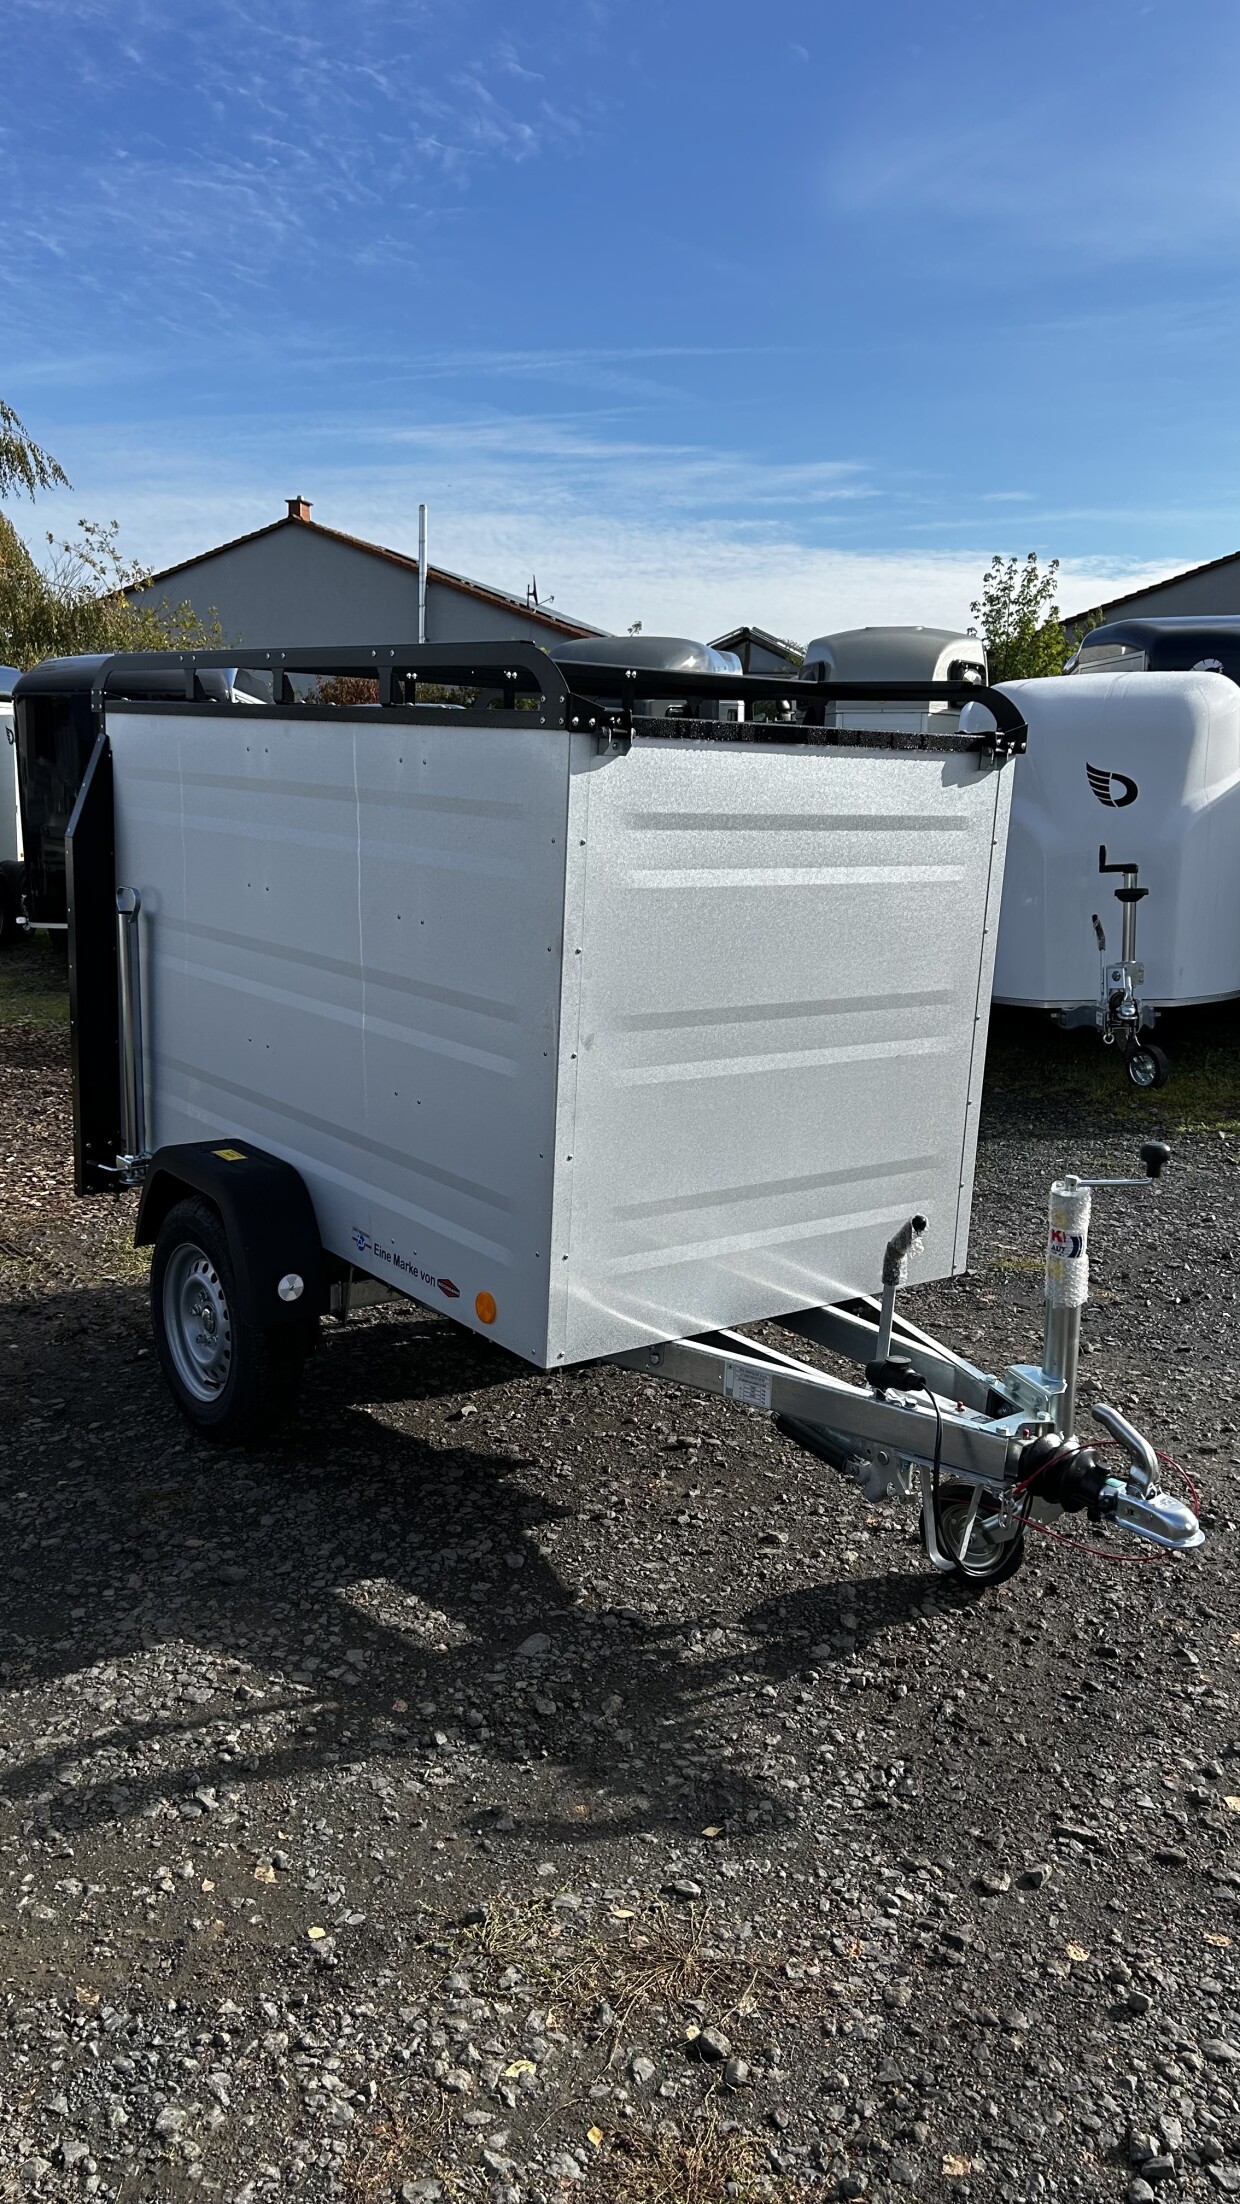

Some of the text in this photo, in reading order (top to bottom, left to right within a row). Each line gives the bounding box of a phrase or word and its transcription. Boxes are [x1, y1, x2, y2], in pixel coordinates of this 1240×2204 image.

[374, 1243, 435, 1287] Eine Marke von
